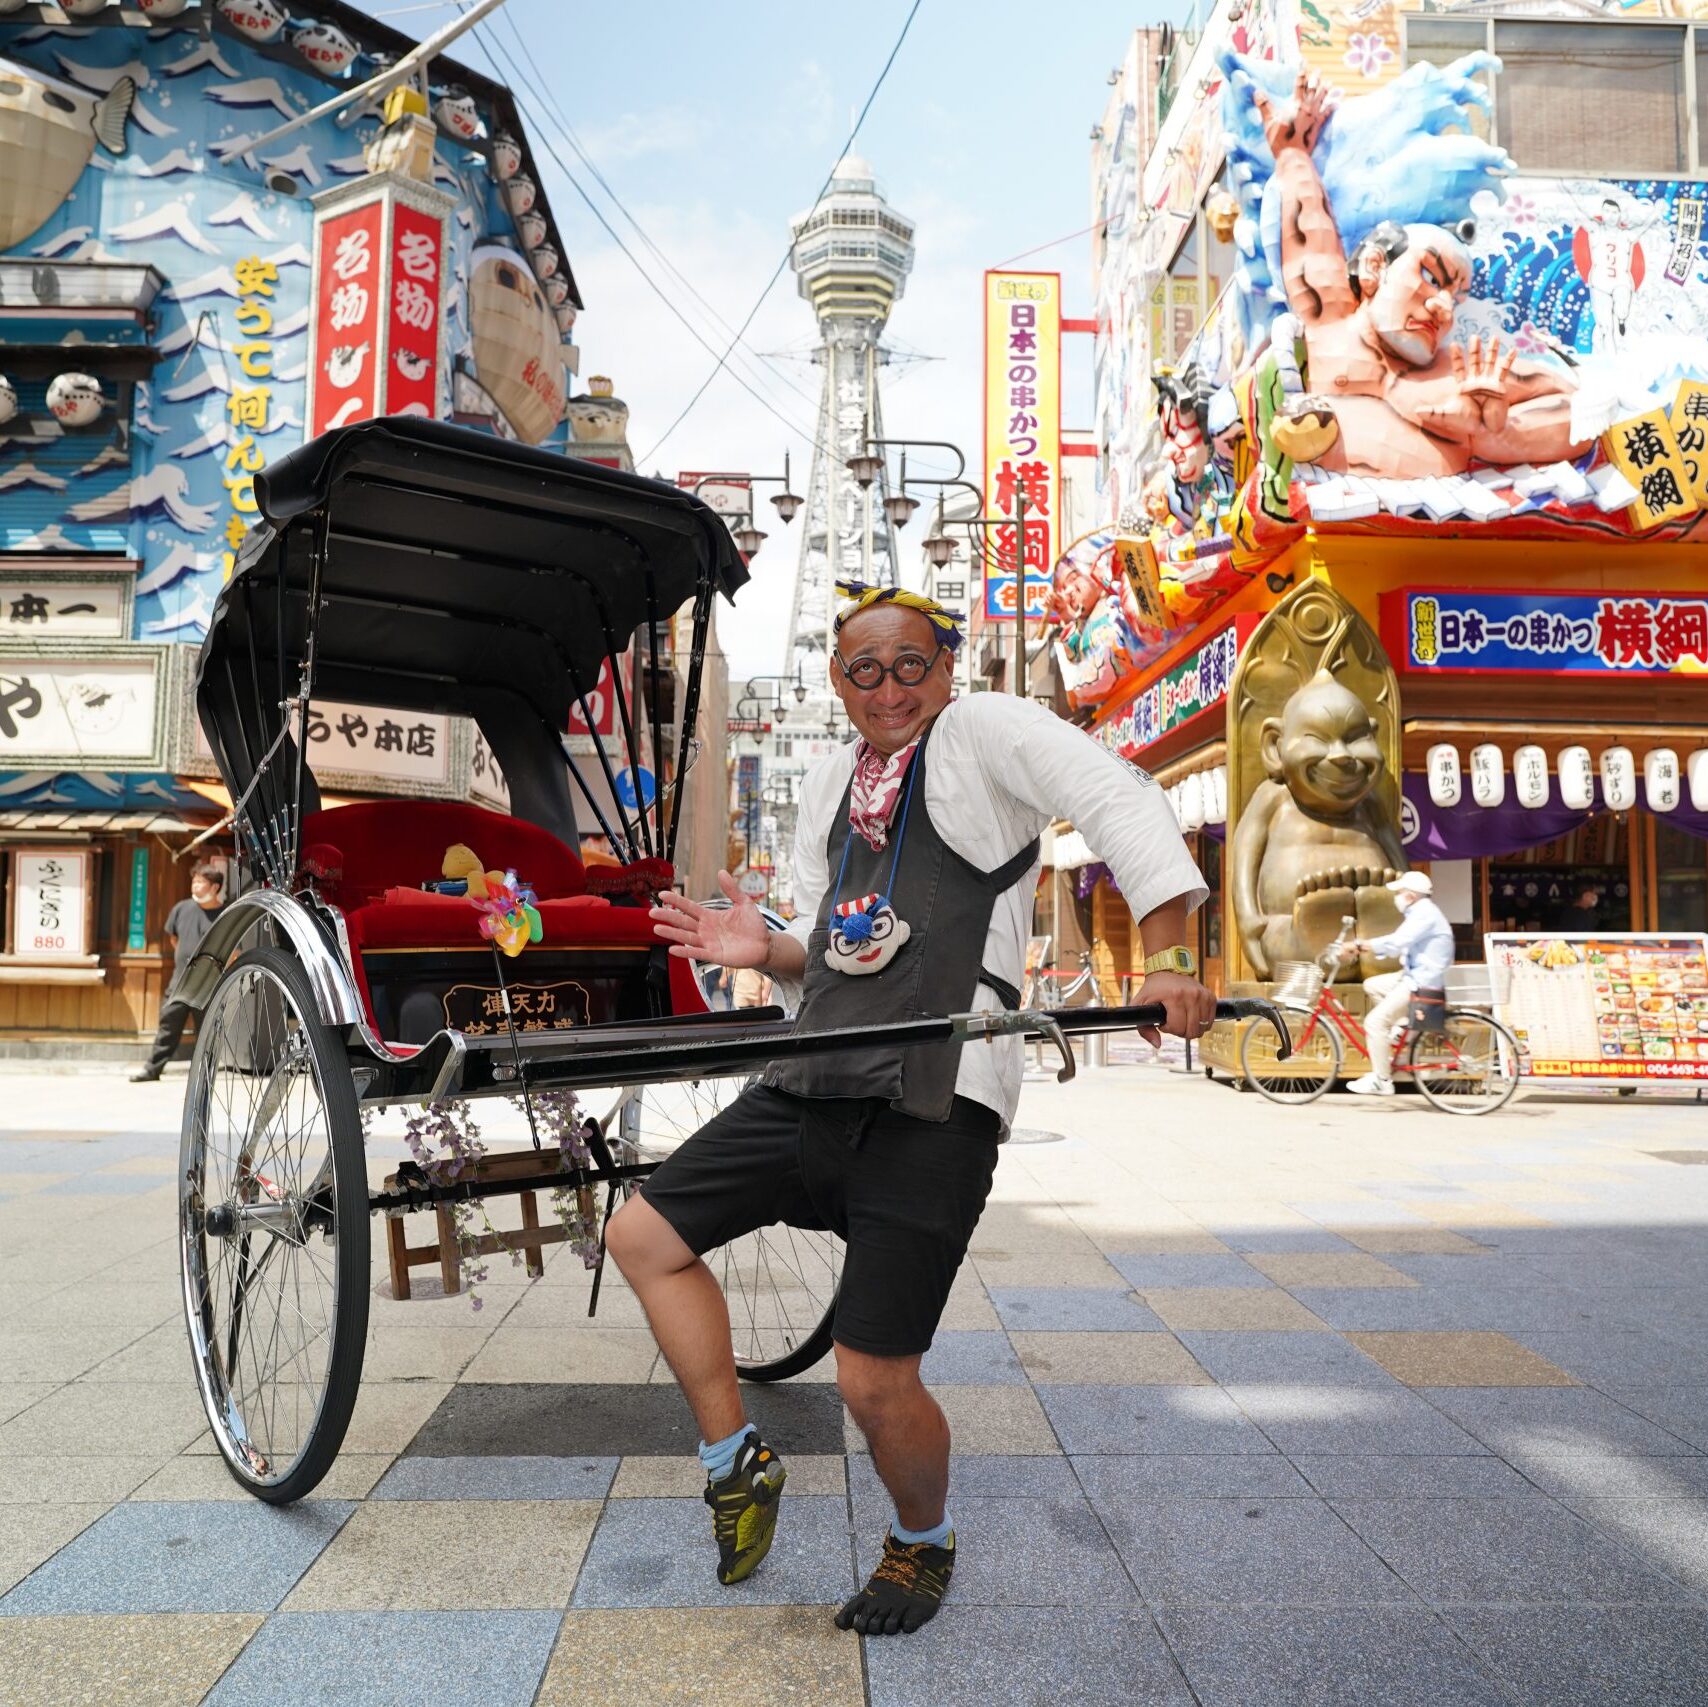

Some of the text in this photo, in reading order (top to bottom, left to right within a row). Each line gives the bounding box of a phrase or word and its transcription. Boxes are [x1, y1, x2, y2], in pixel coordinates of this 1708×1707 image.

[333, 228, 370, 332] 名物
[397, 229, 436, 332] 名物
[1008, 304, 1038, 457] 日本一の串かつ
[1623, 421, 1684, 517] 横綱
[994, 461, 1050, 574] 横綱
[0, 593, 97, 624] 本一
[1415, 600, 1436, 660] 新世界
[1440, 614, 1593, 650] 日本一の串かつ
[1597, 602, 1708, 665] 横綱
[1440, 760, 1455, 799] 串かつ
[1658, 765, 1673, 804] 海老
[34, 936, 65, 949] 880
